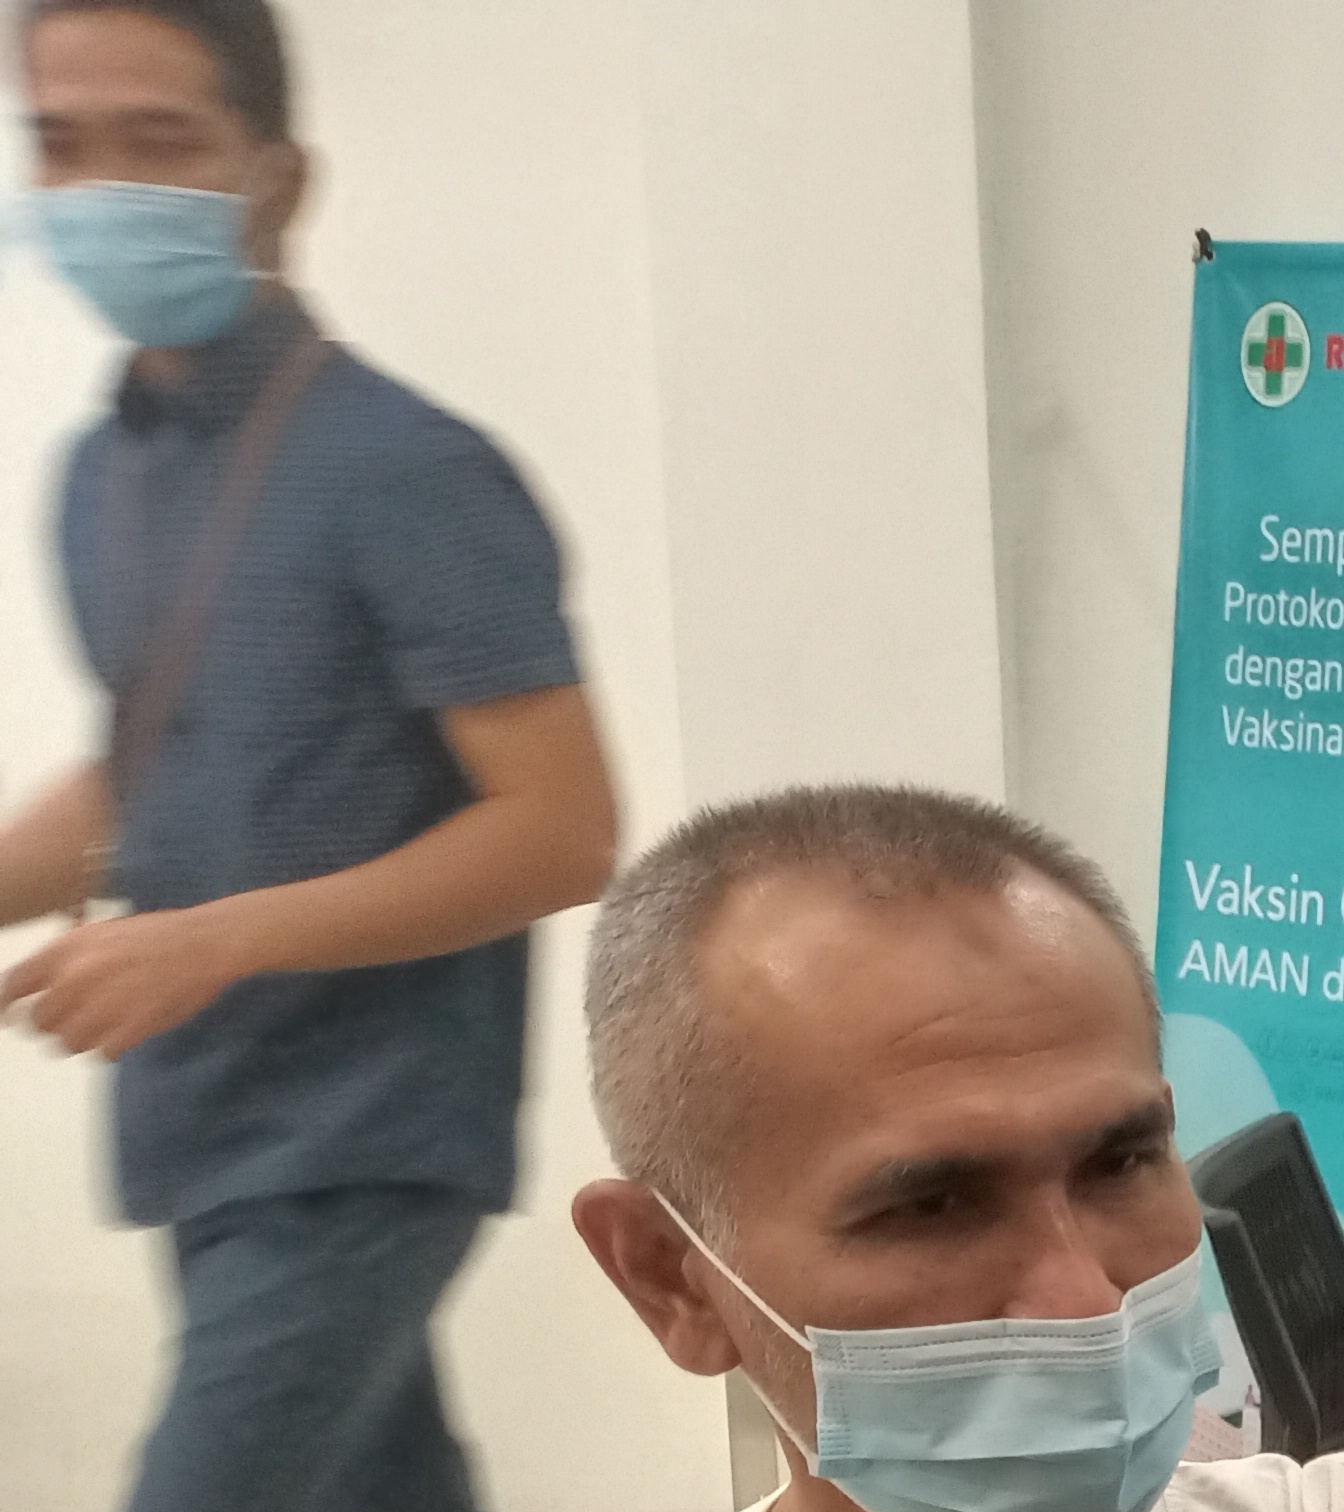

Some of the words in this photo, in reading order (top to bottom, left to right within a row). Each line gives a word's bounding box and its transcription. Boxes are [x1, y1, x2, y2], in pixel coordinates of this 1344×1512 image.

[1225, 646, 1342, 698] dengan
[1186, 860, 1324, 927] Vaksin
[1178, 940, 1308, 996] AMAN
